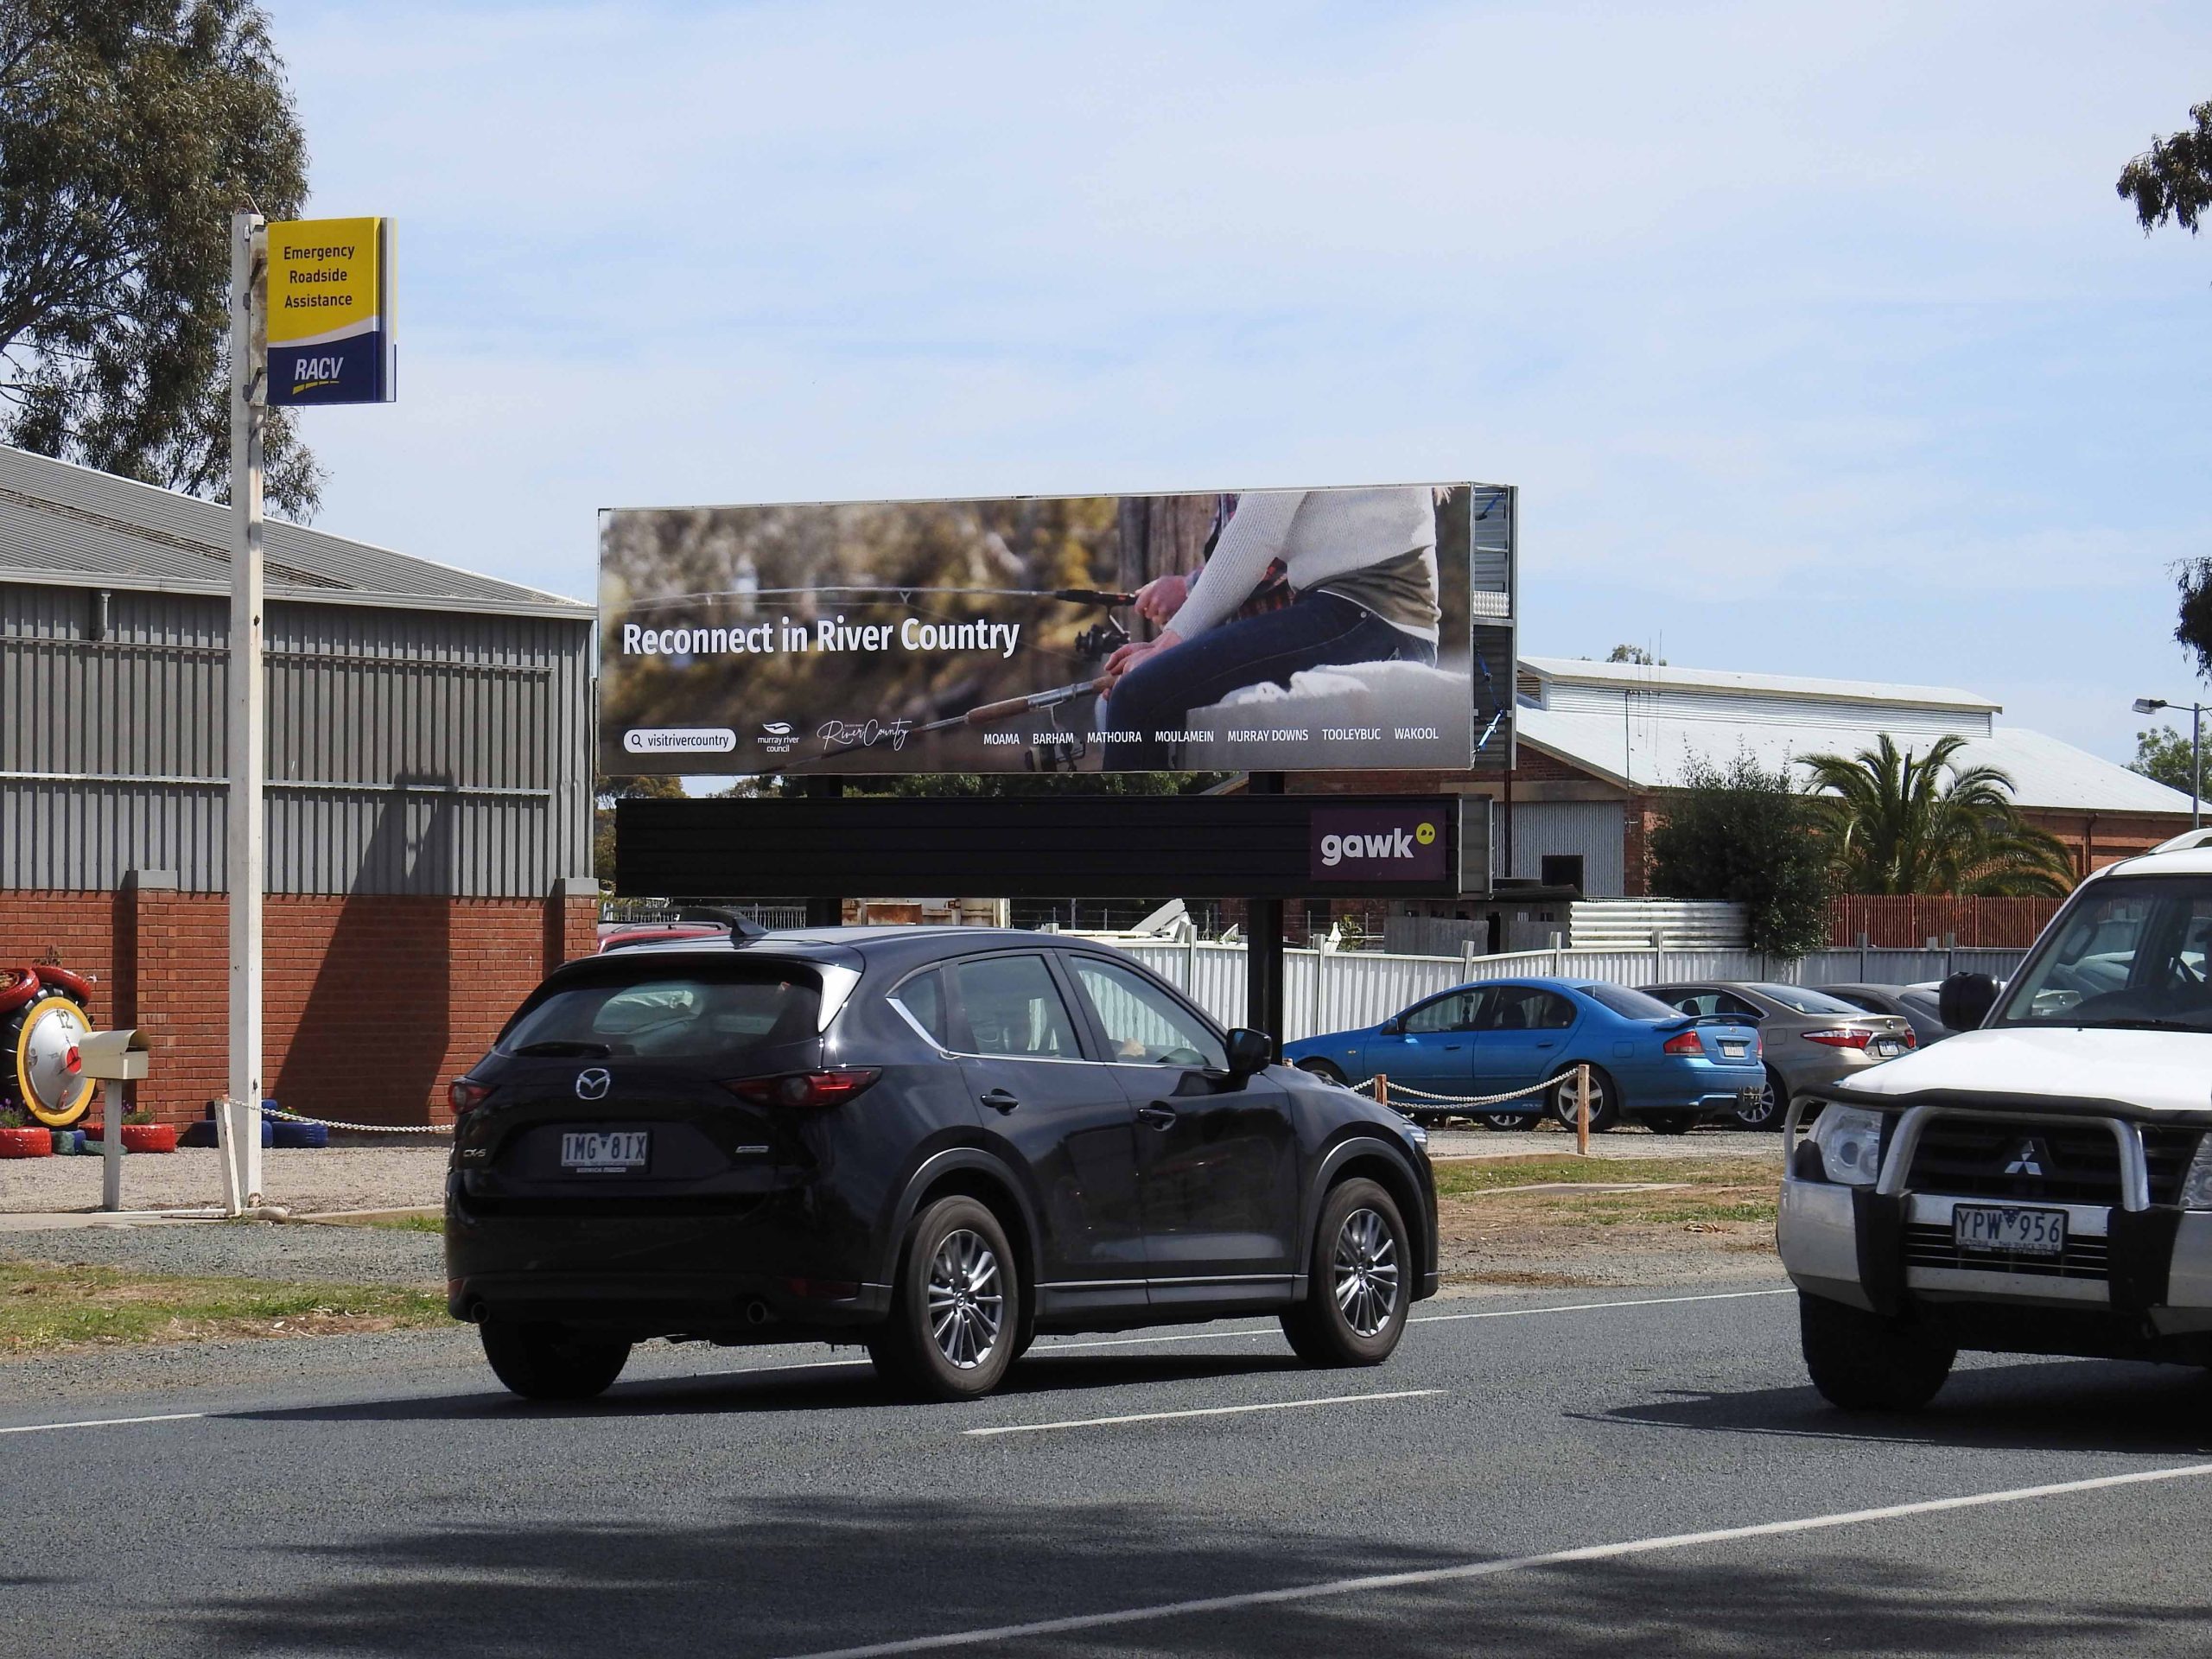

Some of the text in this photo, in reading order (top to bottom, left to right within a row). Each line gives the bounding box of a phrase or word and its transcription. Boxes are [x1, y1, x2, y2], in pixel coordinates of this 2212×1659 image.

[283, 245, 355, 261] Emergency
[289, 268, 347, 283] Roadside
[284, 294, 353, 308] Assistance
[295, 357, 344, 380] RACV
[623, 615, 1020, 658] Reconnect in River Country
[647, 734, 729, 748] visitrivercountry
[757, 735, 800, 746] murray river
[817, 718, 912, 751] River Country
[983, 728, 1440, 745] MOAMA BARHAM MATHOURA MOULAMEIN MURRAY DOWNS TOOLEYBUC WAKOOL
[766, 744, 790, 753] council
[1320, 828, 1414, 867] gawk
[565, 1135, 597, 1160] 1MG
[1957, 1211, 2060, 1243] YPW 956
